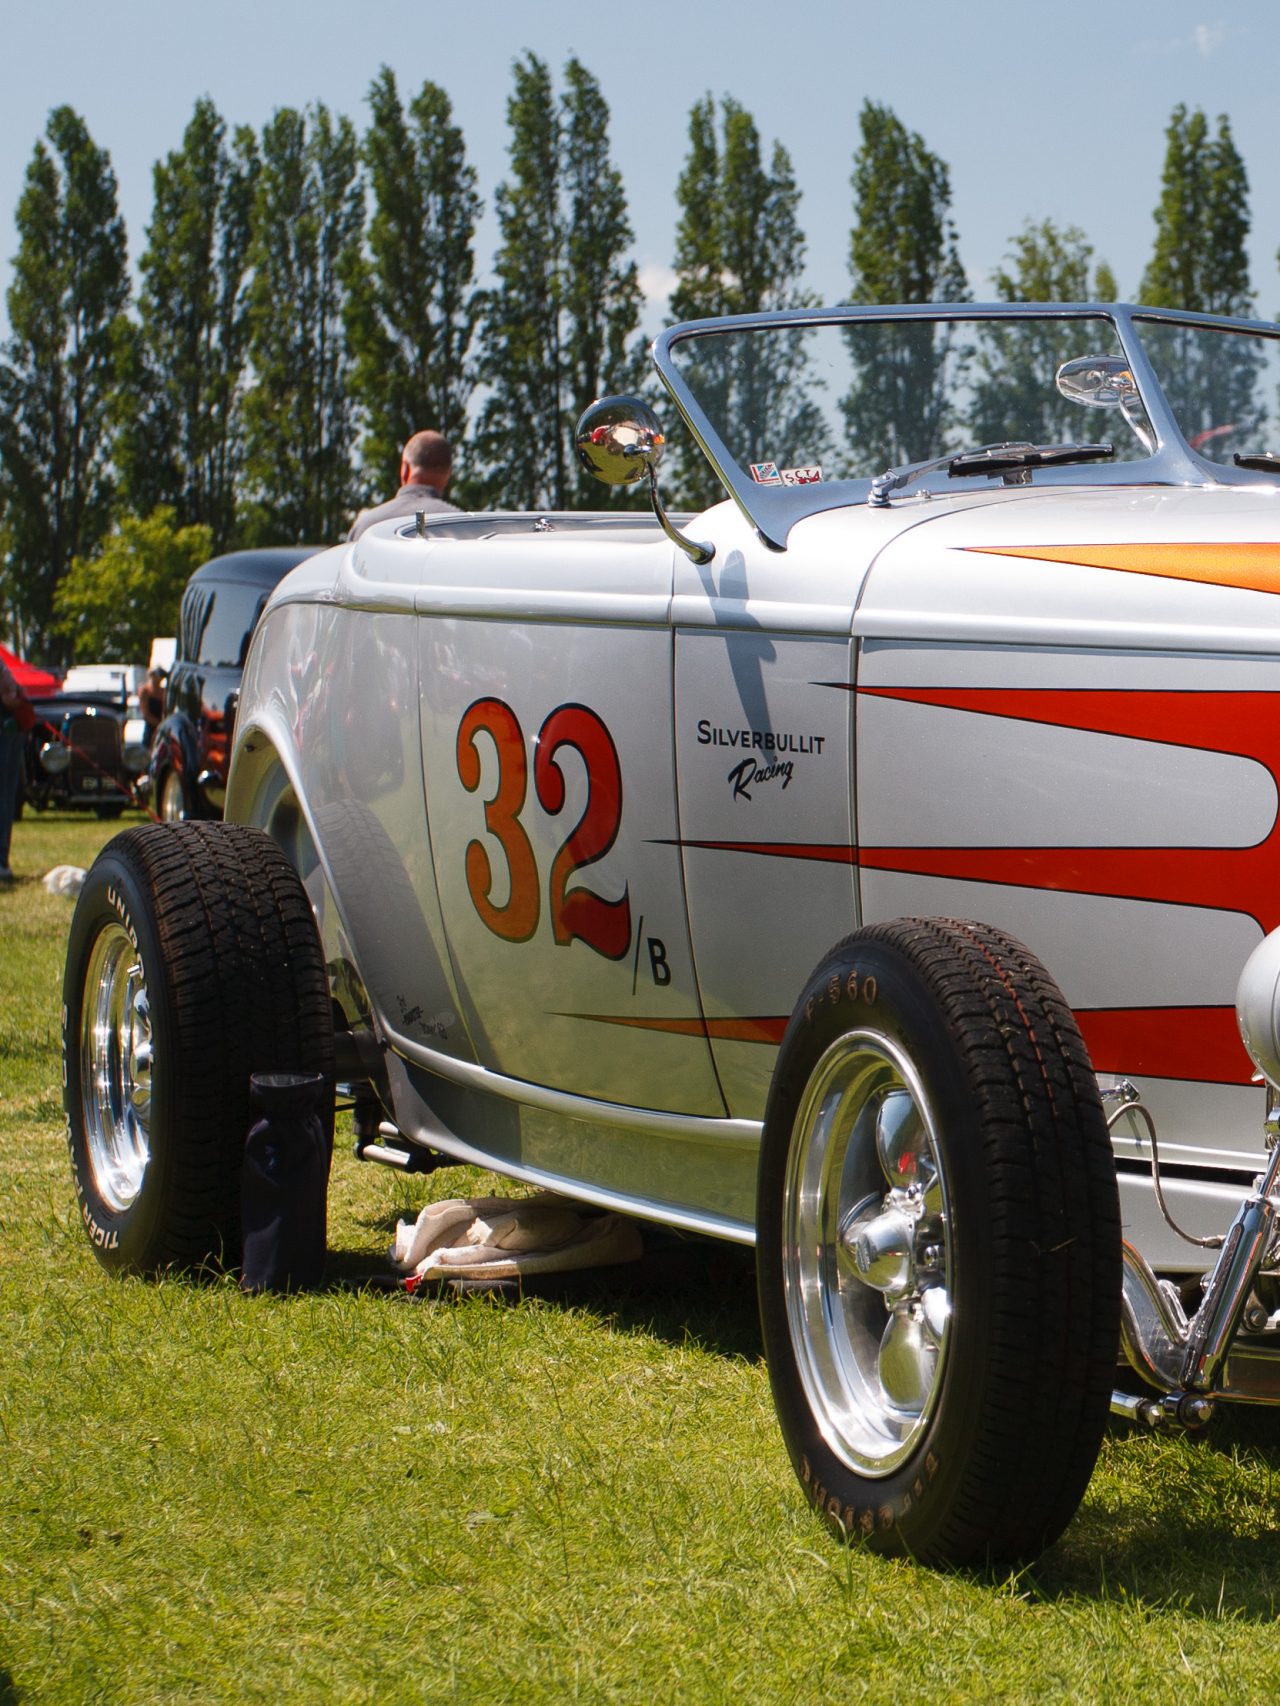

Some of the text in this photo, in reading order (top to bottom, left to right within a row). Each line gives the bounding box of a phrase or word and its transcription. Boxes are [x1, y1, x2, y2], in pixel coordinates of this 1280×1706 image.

[697, 719, 825, 754] SILVERBULLIT
[727, 755, 794, 801] Racing
[456, 696, 632, 961] 32
